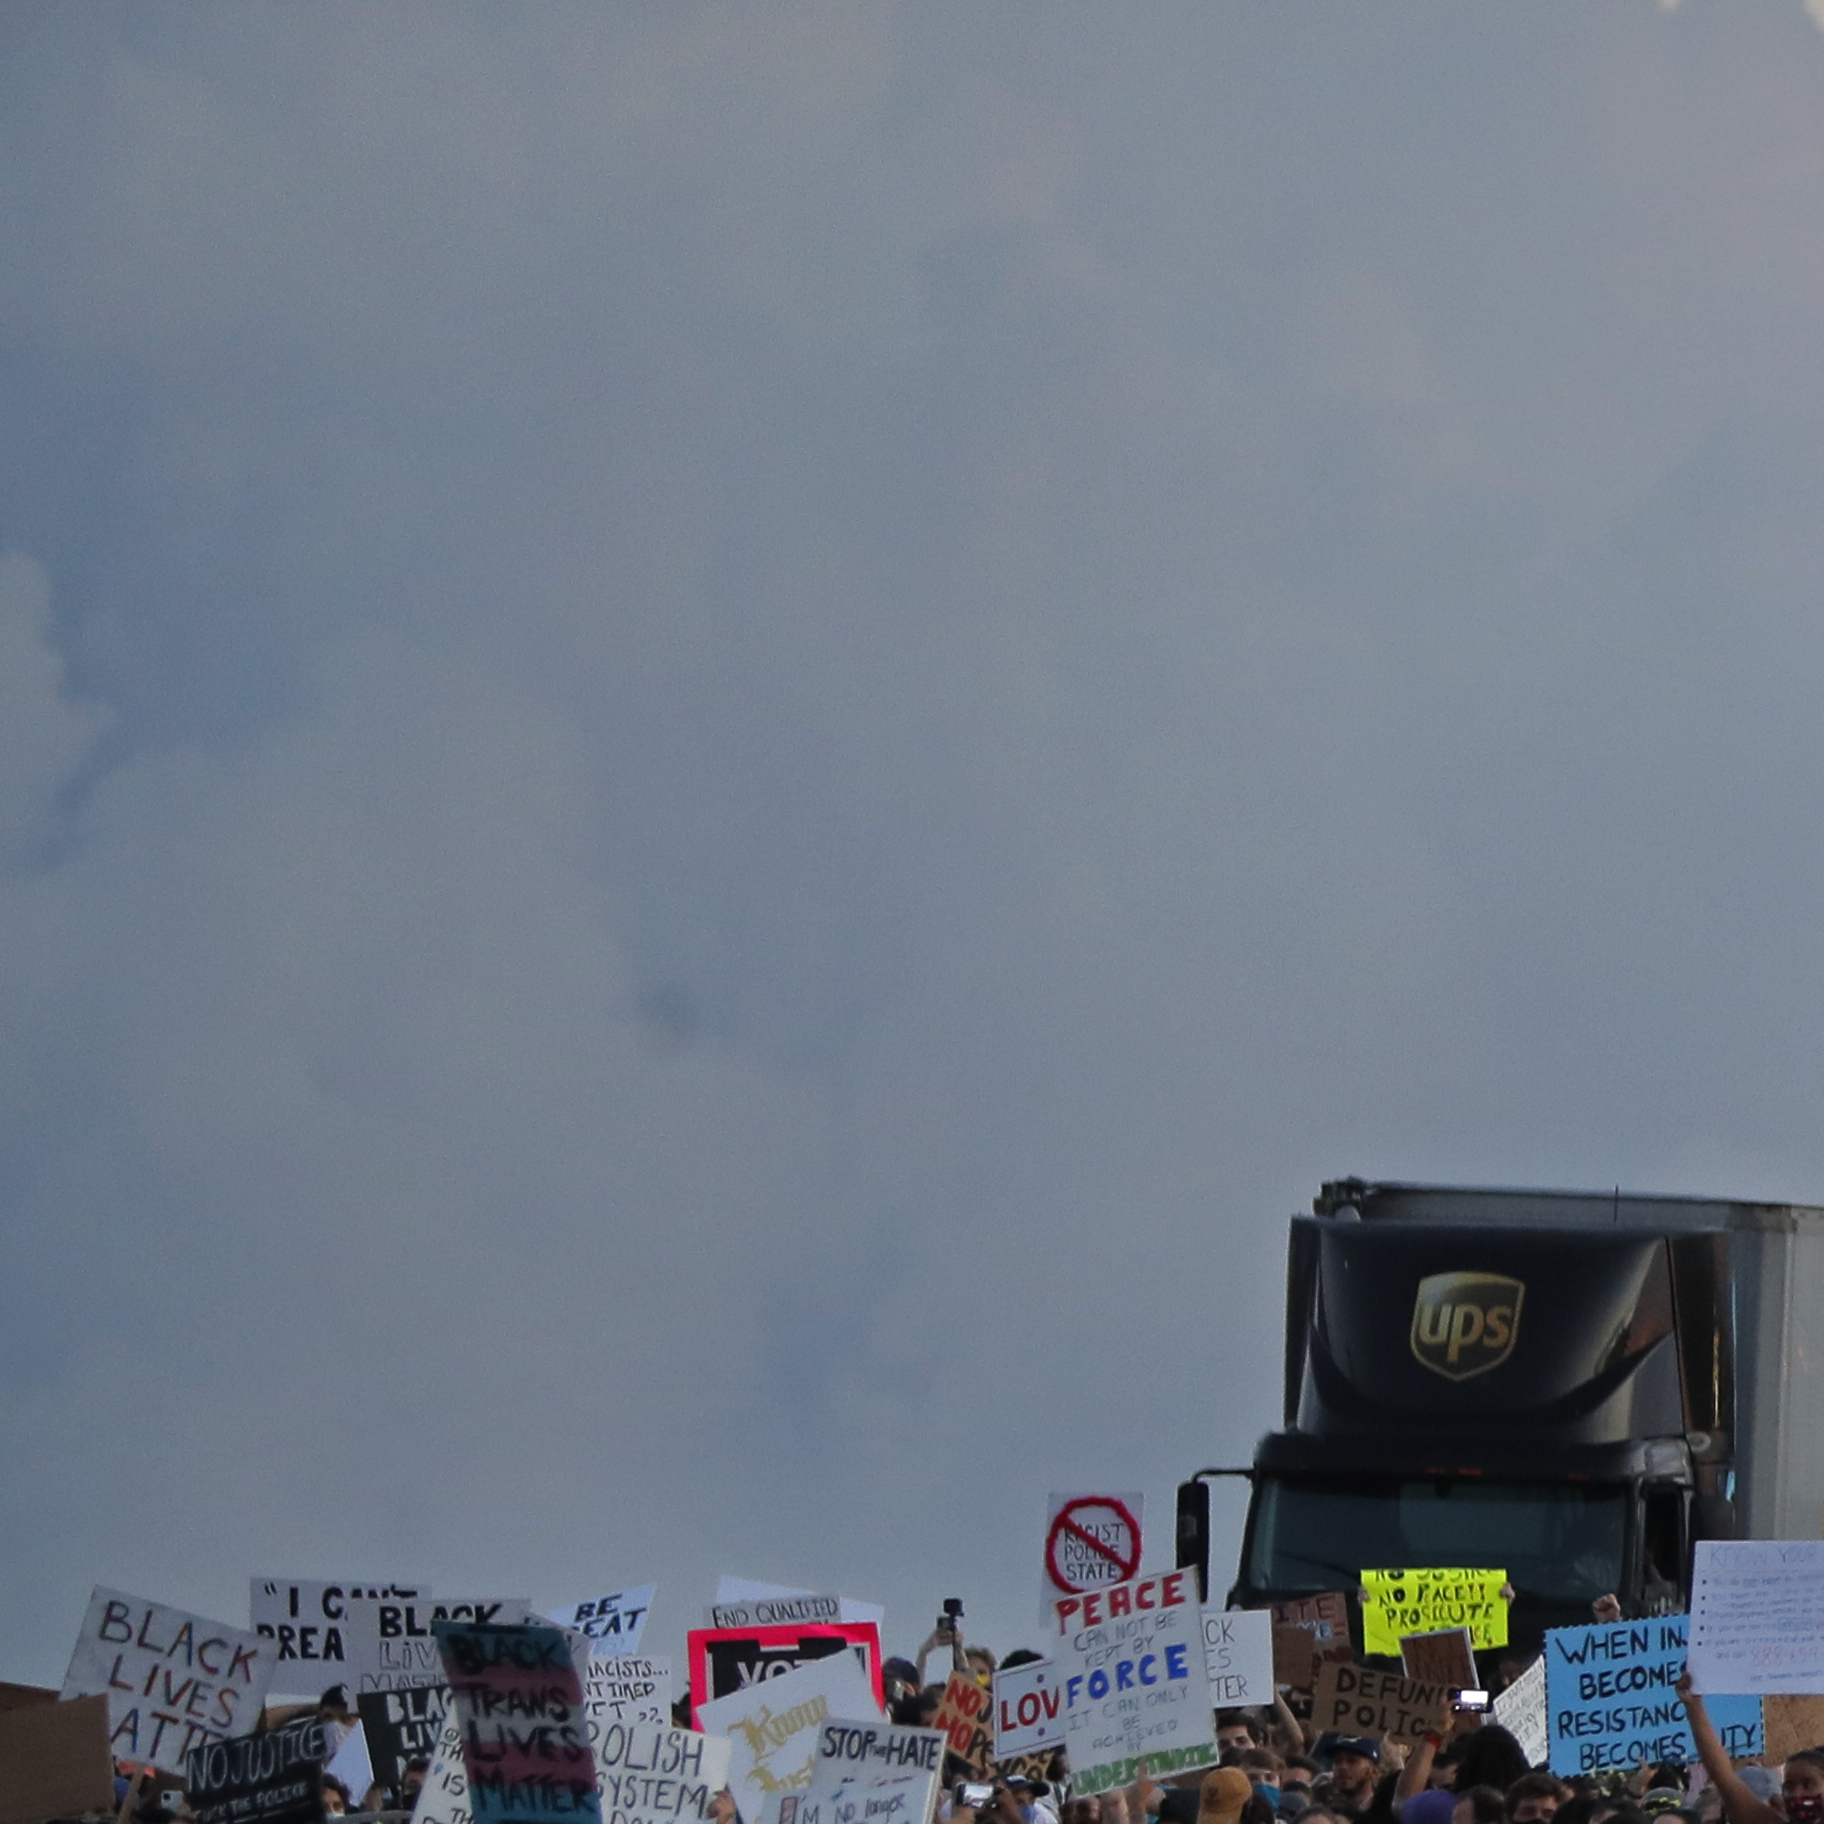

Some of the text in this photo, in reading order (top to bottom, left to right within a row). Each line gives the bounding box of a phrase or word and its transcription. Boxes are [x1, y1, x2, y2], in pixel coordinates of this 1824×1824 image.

[1066, 1561, 1119, 1582] STATE
[712, 1597, 839, 1629] END QUALIFIED
[1056, 1572, 1186, 1637] PEACE
[1379, 1588, 1406, 1608] NO
[99, 1600, 258, 1683] BLACK
[1115, 1616, 1148, 1639] NOT
[1555, 1626, 1649, 1664] WHEN
[445, 1633, 557, 1676] BLACK
[1066, 1643, 1188, 1709] FORCE
[108, 1654, 241, 1729] LIVES
[452, 1682, 571, 1723] TRANS
[944, 1679, 983, 1717] NO
[186, 1722, 326, 1793] NO JUSTICE
[467, 1719, 581, 1762] LIVES
[820, 1725, 877, 1763] STOP
[885, 1733, 943, 1771] HATE
[1579, 1732, 1686, 1771] BECOMES
[474, 1768, 600, 1814] MATTER
